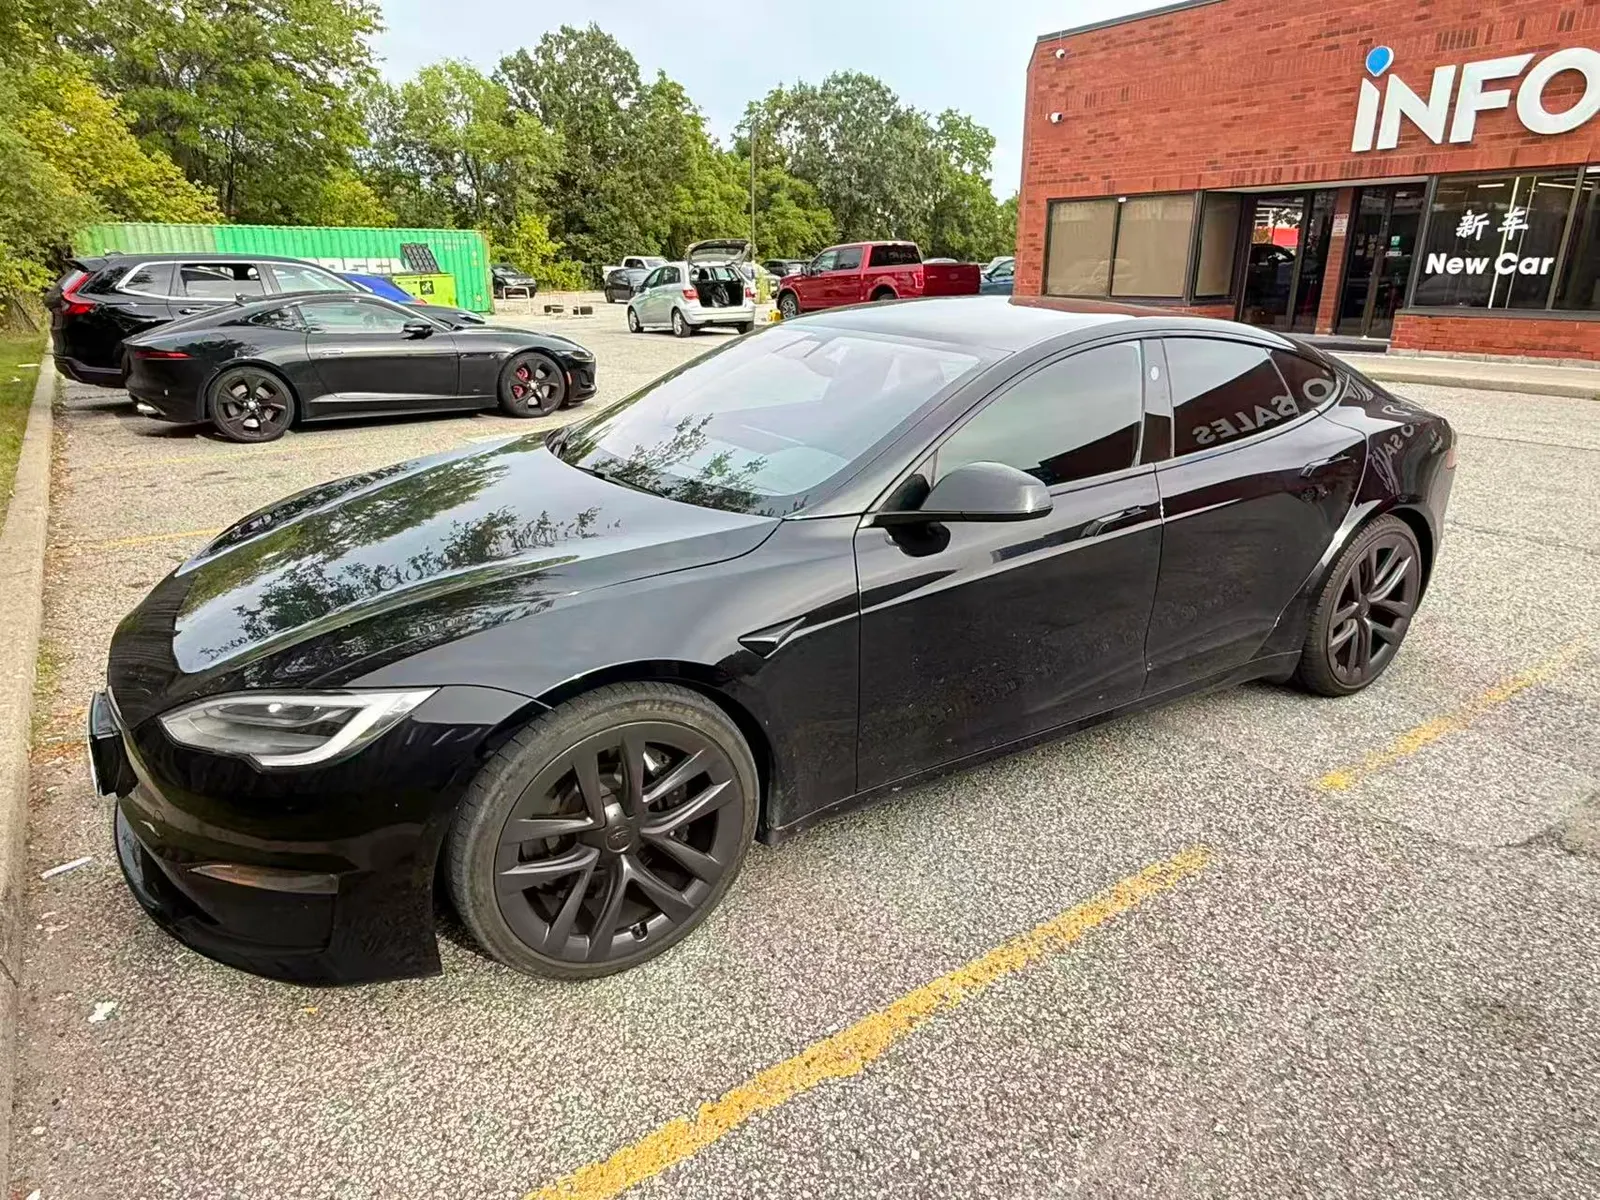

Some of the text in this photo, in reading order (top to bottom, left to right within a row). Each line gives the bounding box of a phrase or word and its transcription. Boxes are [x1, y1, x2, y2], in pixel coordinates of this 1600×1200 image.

[1455, 206, 1529, 241] 新车
[1425, 252, 1555, 275] New Car
